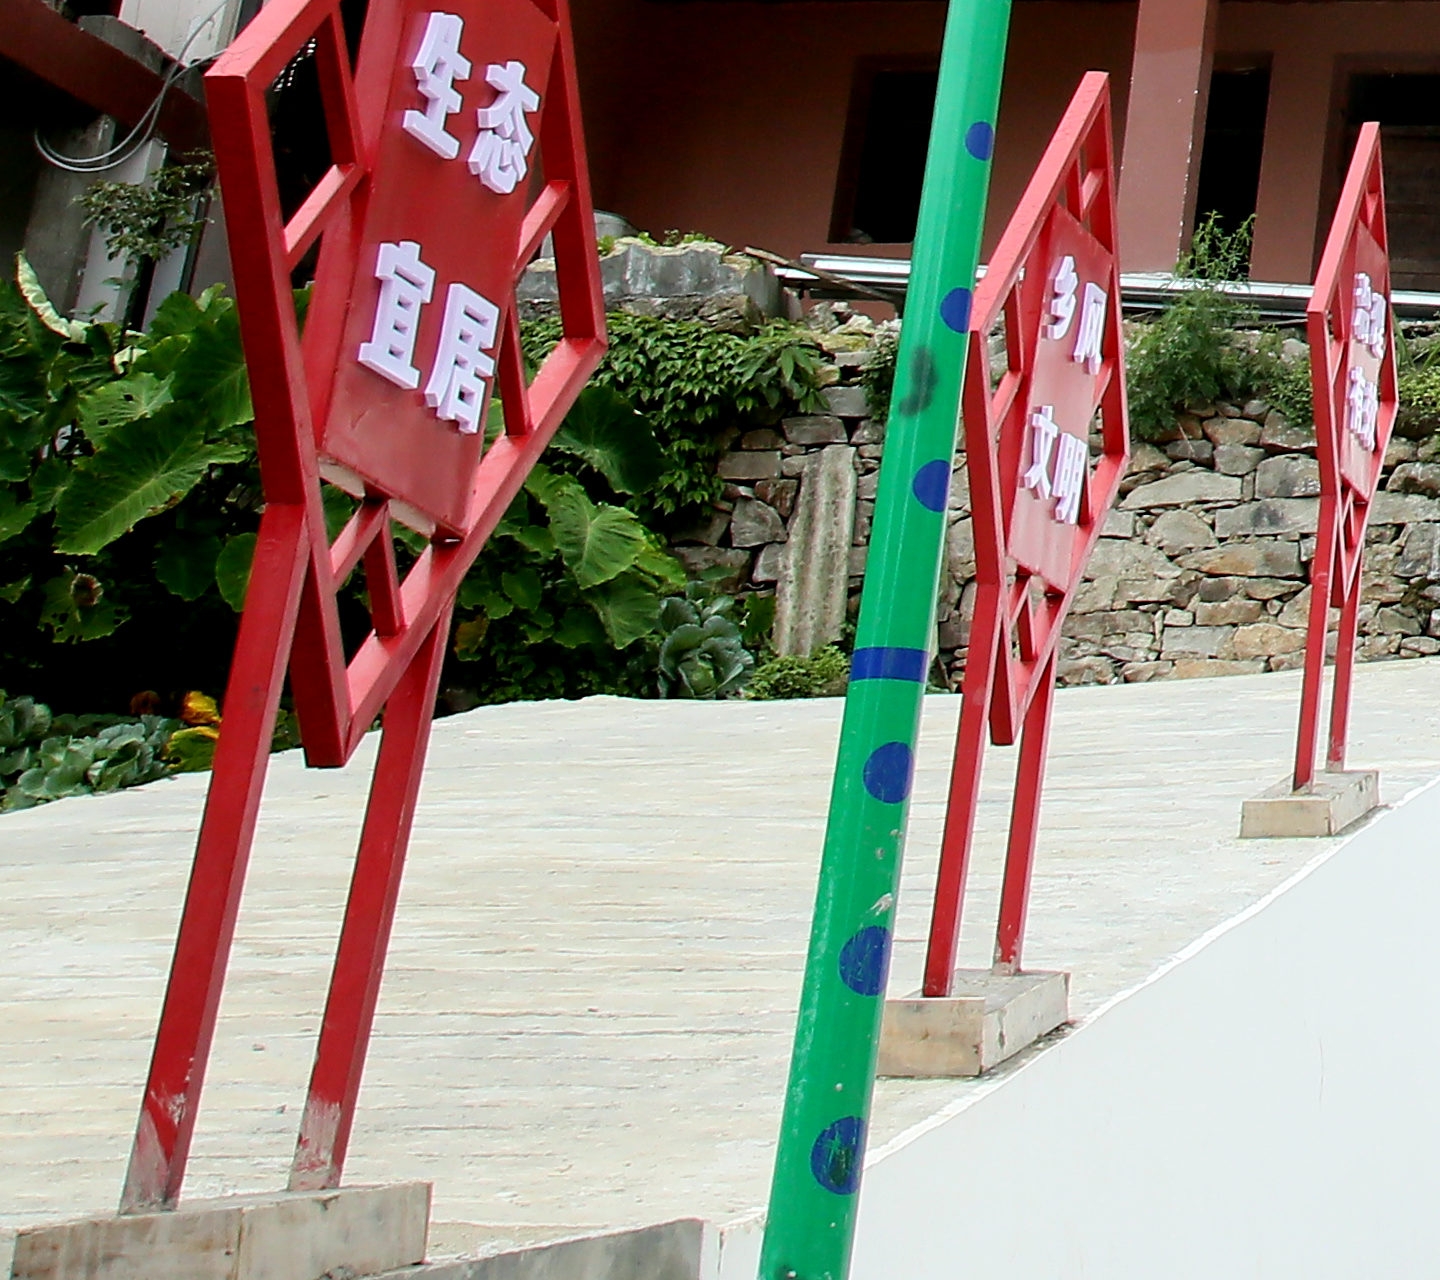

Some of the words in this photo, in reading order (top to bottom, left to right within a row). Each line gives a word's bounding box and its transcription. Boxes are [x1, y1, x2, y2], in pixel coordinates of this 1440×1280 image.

[402, 11, 541, 195] 生态
[357, 240, 500, 434] 宜居
[1046, 255, 1107, 375] 乡风
[1022, 405, 1088, 525] 文明
